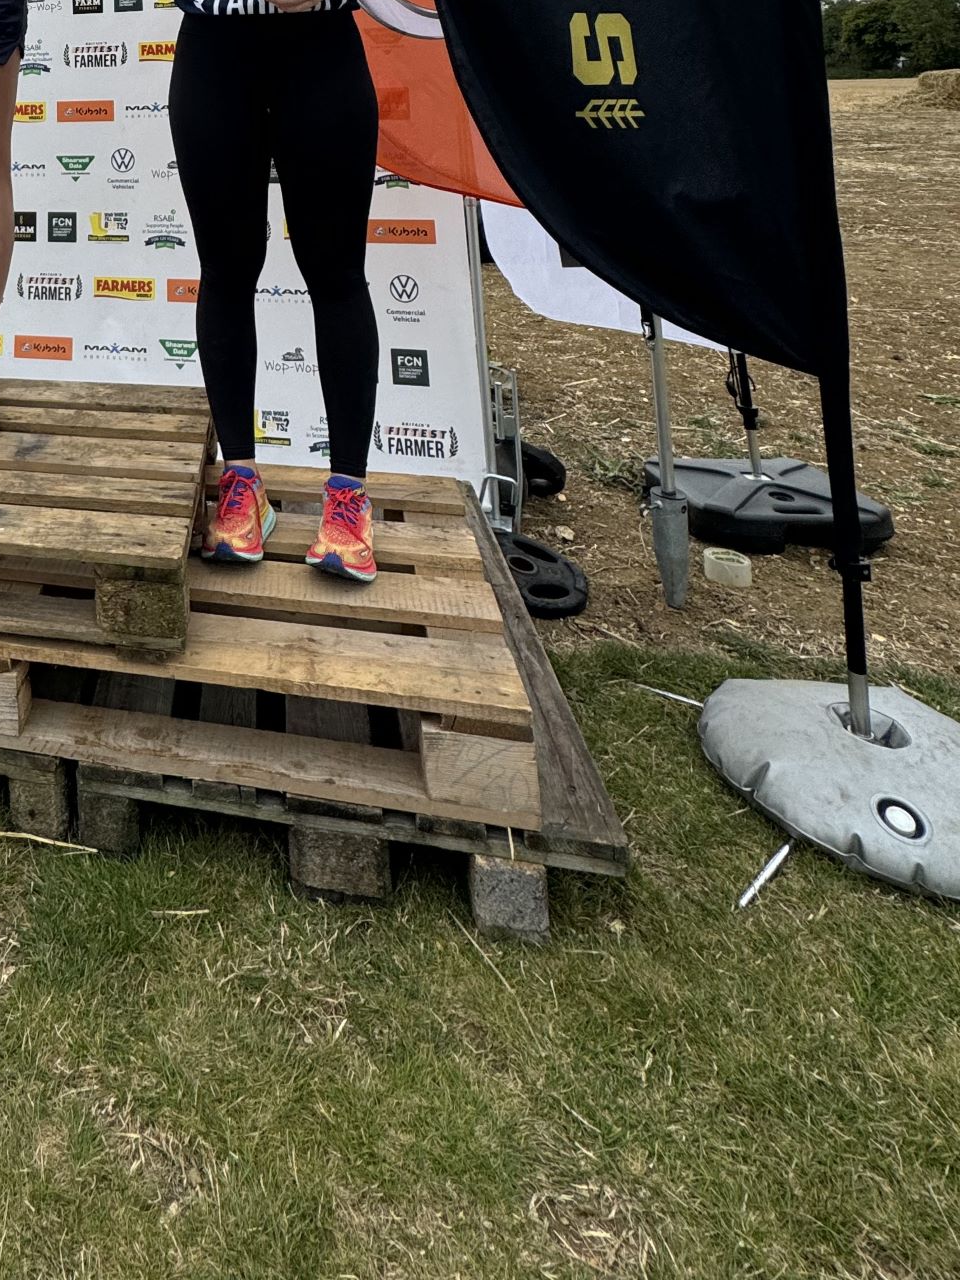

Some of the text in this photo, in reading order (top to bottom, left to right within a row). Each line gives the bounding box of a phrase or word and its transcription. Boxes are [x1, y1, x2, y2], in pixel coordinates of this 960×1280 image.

[27, 1, 63, 13] -Wops
[74, 45, 120, 54] FITTEST
[141, 44, 176, 56] FARM
[74, 54, 117, 68] FARMER
[14, 104, 44, 115] MERS
[75, 107, 108, 116] Kubota
[125, 102, 169, 112] MAXA
[13, 161, 46, 171] XAM
[151, 170, 178, 181] Wop-
[52, 218, 73, 227] FCN
[388, 227, 428, 236] Kubota
[28, 276, 75, 285] FITTEST
[96, 279, 153, 293] FARMERS
[28, 285, 72, 301] FARMER
[256, 285, 309, 296] AXAM
[386, 308, 426, 316] Commercial
[33, 343, 66, 354] Kubota
[84, 342, 147, 354] MAXAM
[397, 356, 423, 367] FCN
[264, 360, 319, 377] Wop-Wop
[389, 426, 447, 439] FITTEST
[388, 437, 445, 459] FARMER
